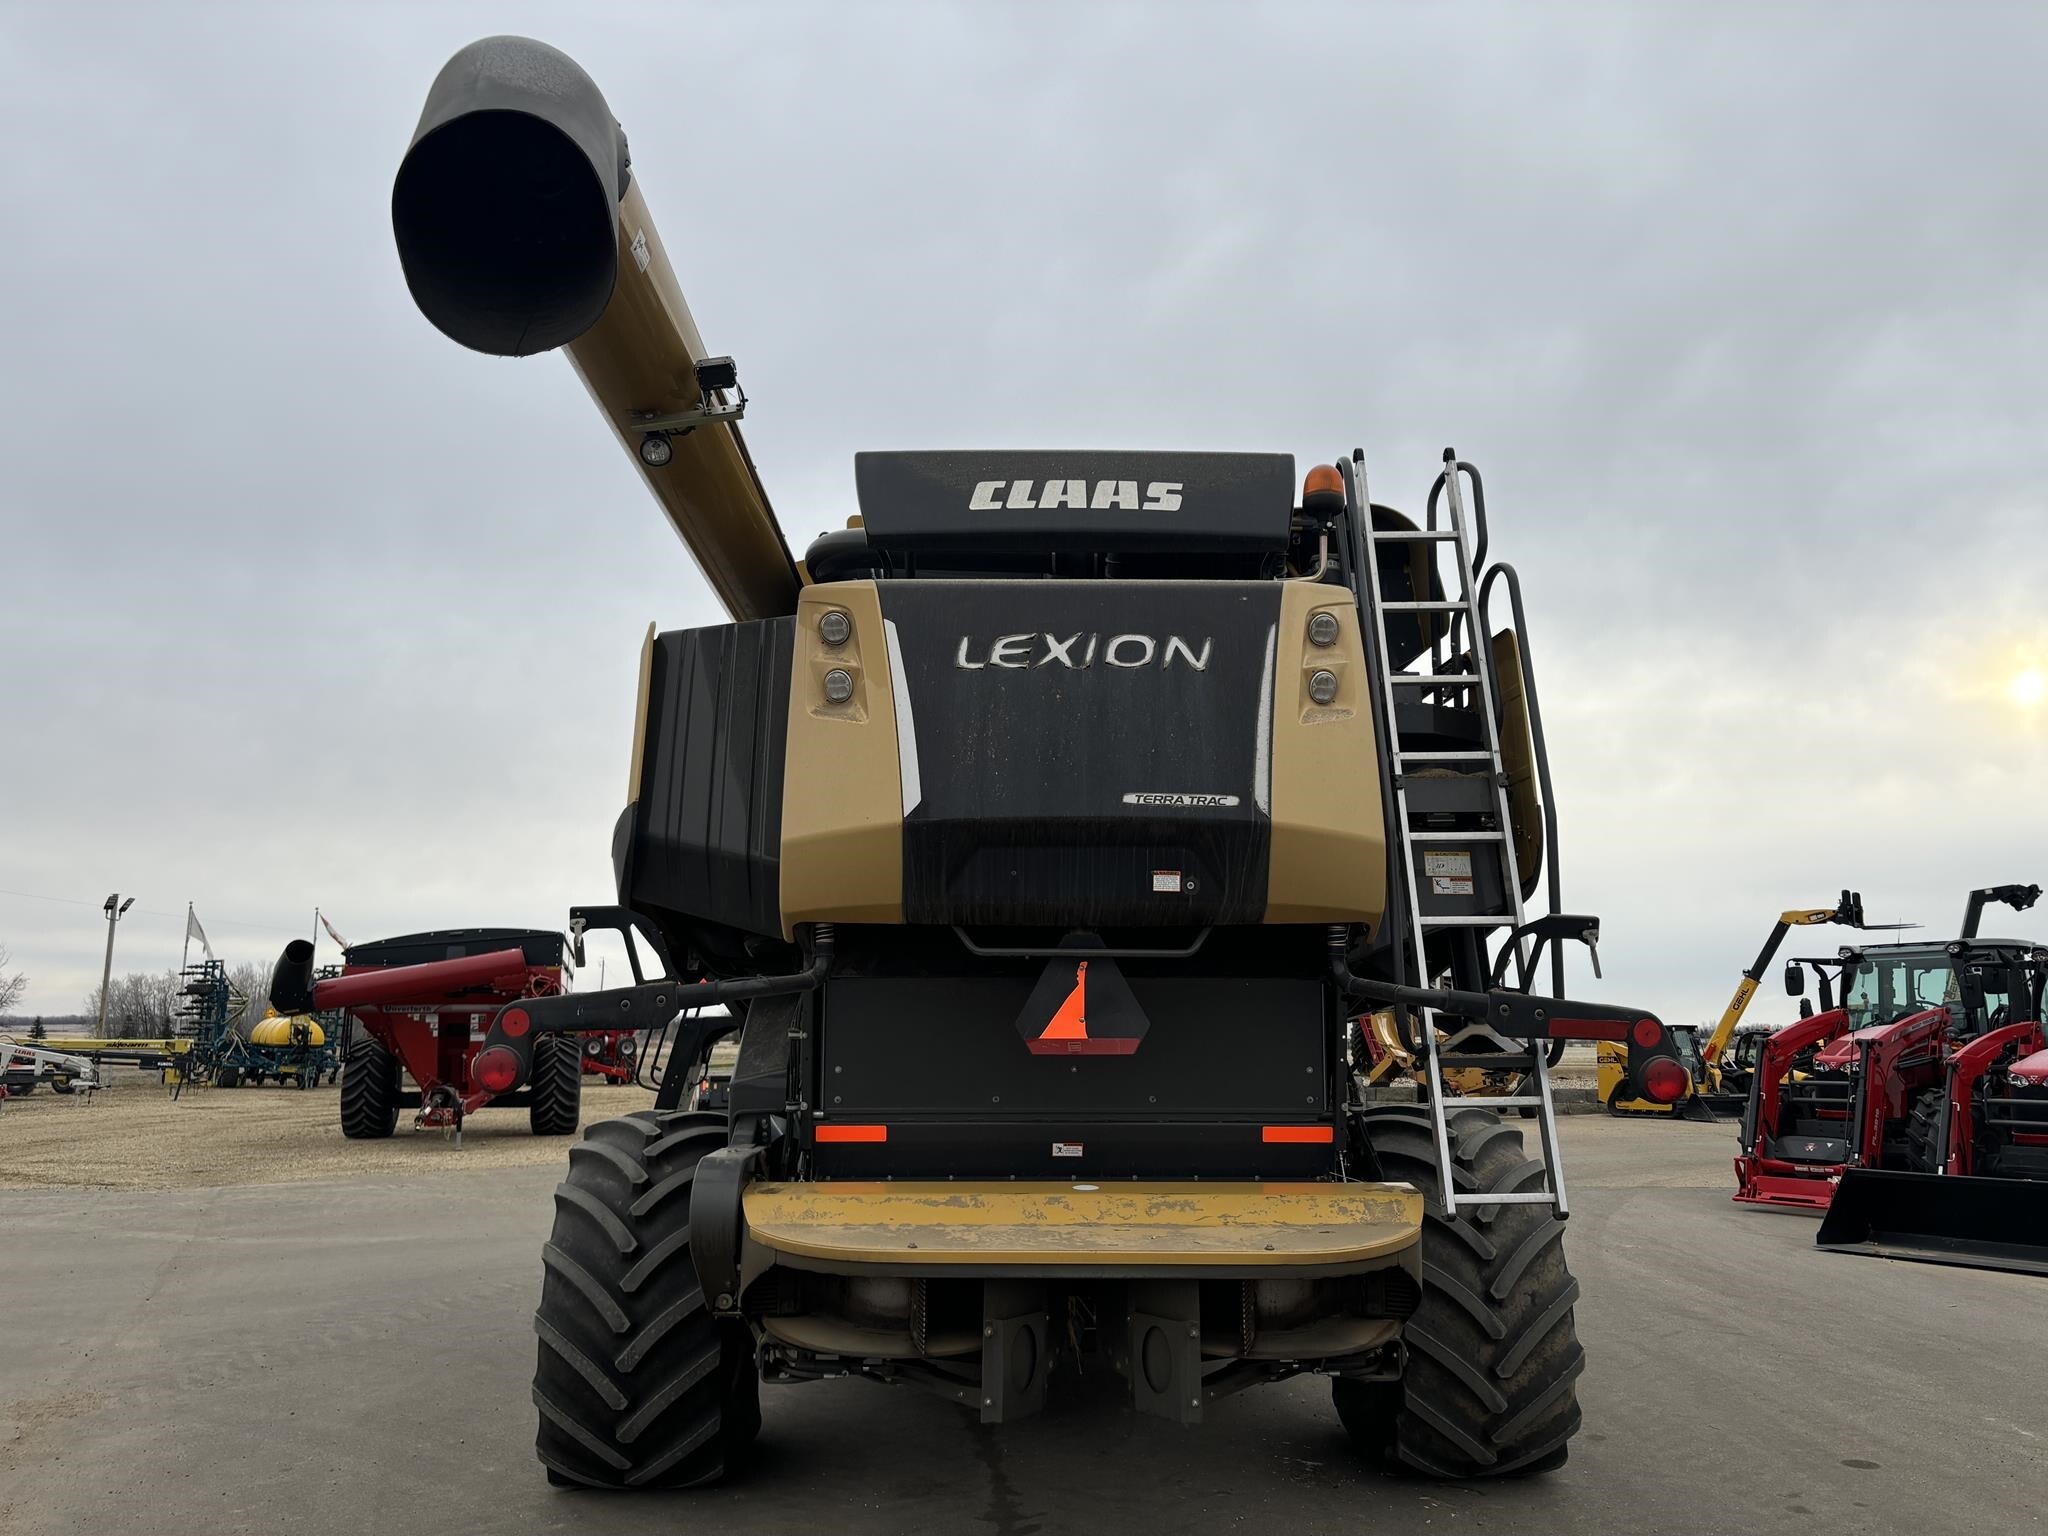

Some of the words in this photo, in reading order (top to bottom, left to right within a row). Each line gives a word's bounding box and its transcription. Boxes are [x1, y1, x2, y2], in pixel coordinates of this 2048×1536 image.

[969, 479, 1184, 511] CLAAS
[956, 632, 1213, 671] LEXION
[1135, 794, 1185, 805] TERRA
[1188, 796, 1228, 806] TRAC
[1732, 988, 1750, 1010] GEHL
